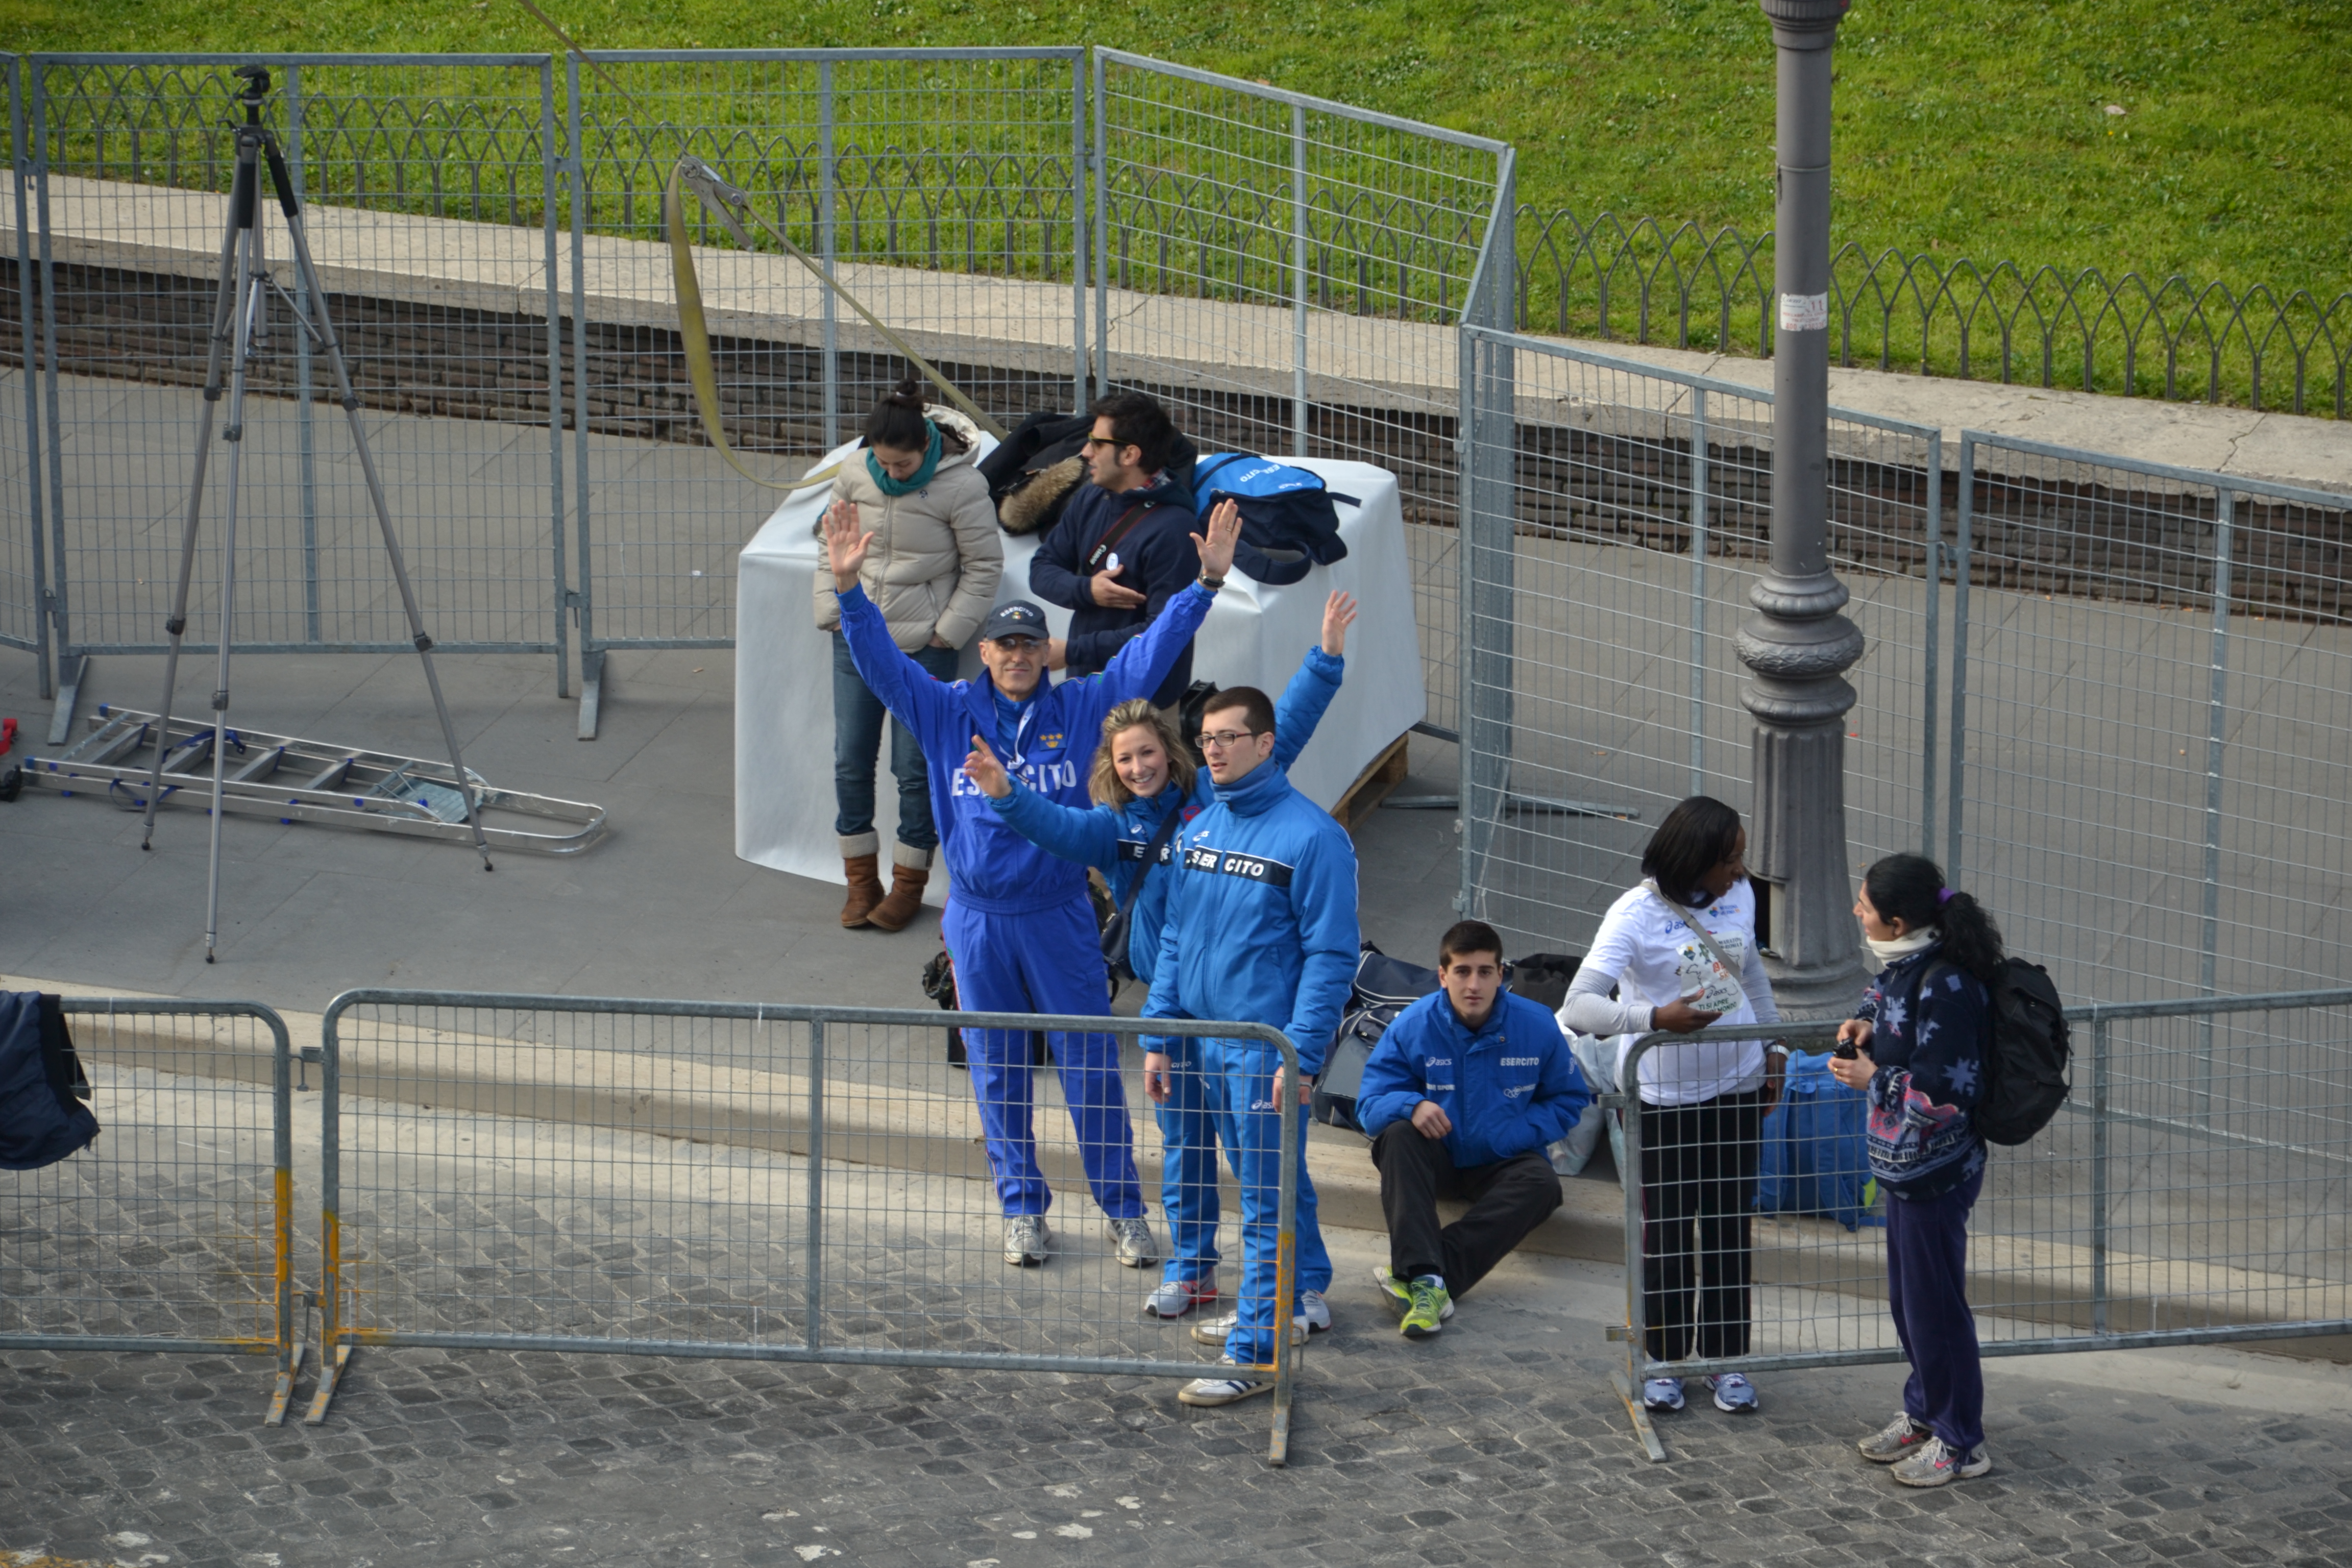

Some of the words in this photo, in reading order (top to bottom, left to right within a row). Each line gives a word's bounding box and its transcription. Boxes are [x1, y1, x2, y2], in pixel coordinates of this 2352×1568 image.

[1089, 544, 1107, 565] Canon
[999, 606, 1034, 617] ESERCITO
[951, 760, 1077, 796] ESCITO
[1713, 998, 1729, 1008] APRE
[1717, 1002, 1737, 1012] MONDO
[1500, 1057, 1539, 1066] ESERCITO
